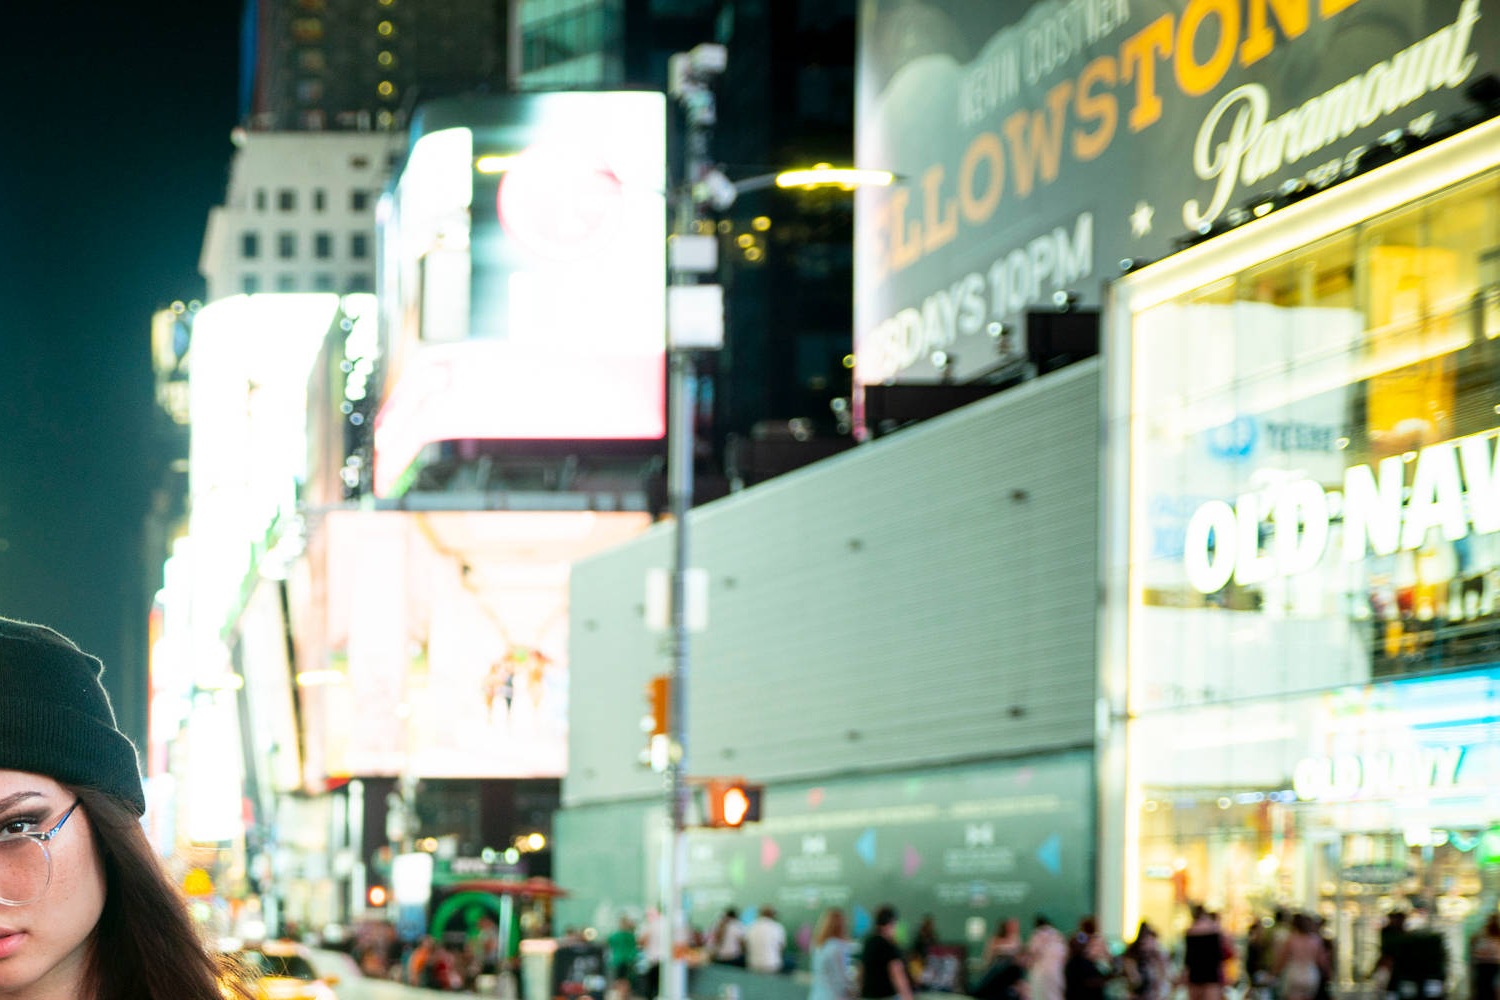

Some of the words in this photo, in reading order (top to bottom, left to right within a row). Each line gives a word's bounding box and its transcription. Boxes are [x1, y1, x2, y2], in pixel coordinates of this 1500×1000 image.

[870, 0, 1356, 274] LLOWSTON
[1183, 0, 1482, 231] Paramount
[988, 211, 1094, 322] 10PM
[1184, 478, 1329, 595] OLD
